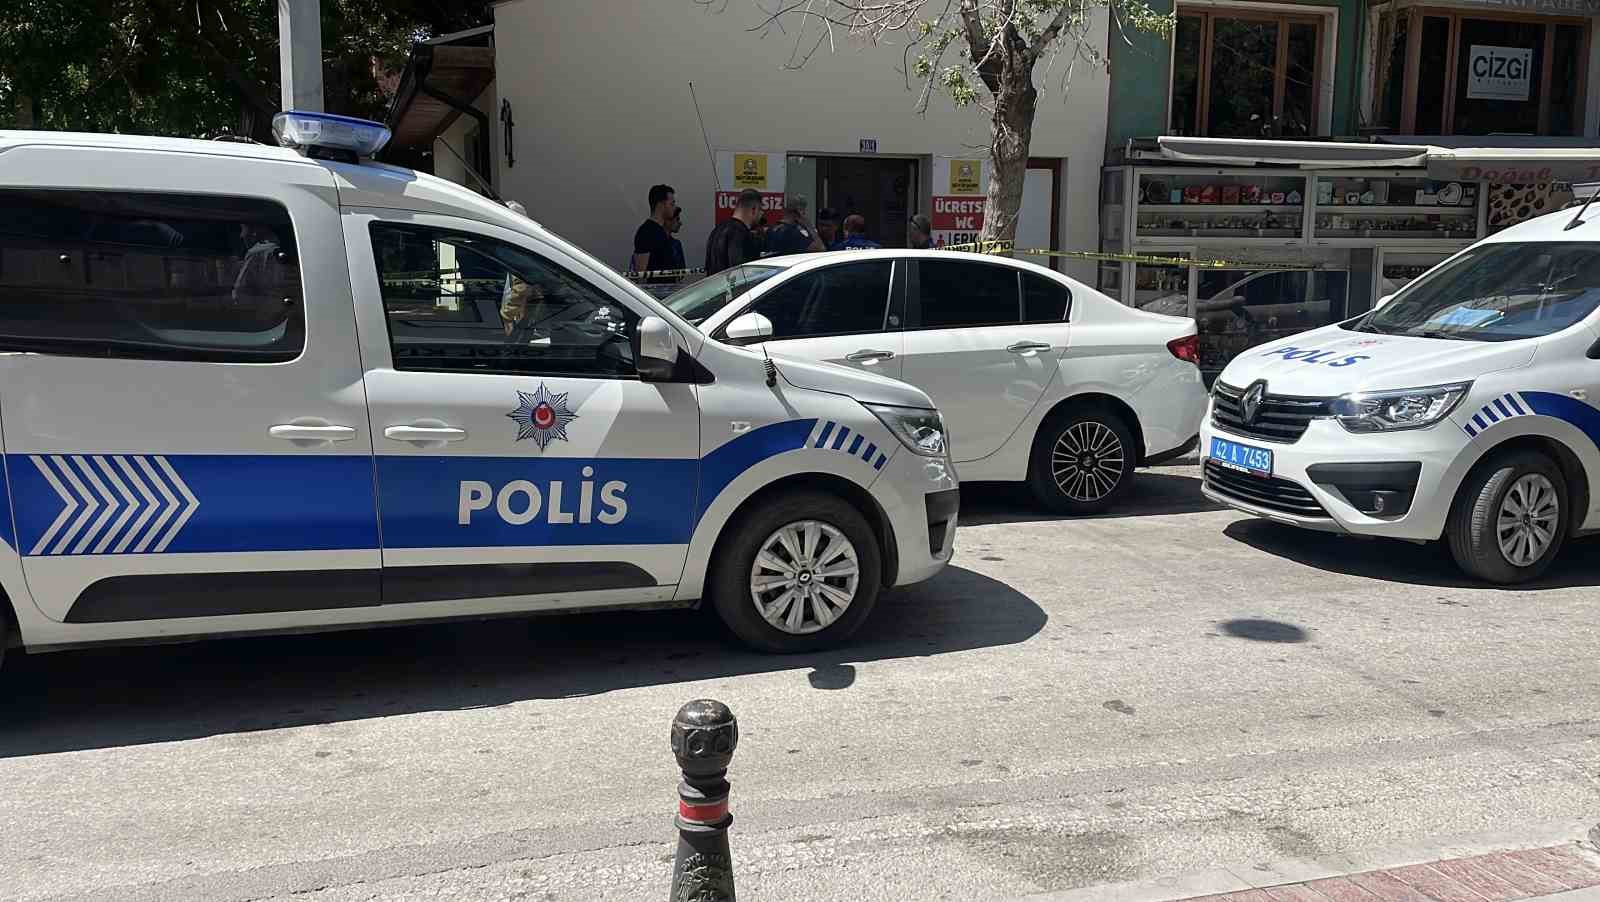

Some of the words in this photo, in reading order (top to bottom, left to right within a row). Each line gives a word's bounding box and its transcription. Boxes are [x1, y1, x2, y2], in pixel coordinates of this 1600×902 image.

[1473, 50, 1529, 83] ÇİZGİ
[718, 192, 783, 210] ÜCSİZ
[935, 197, 985, 213] ÜCRETS
[955, 216, 975, 229] WC
[1215, 440, 1227, 459] 42
[1231, 445, 1238, 464] A
[1243, 447, 1270, 470] 7453
[457, 465, 629, 526] POLİS
